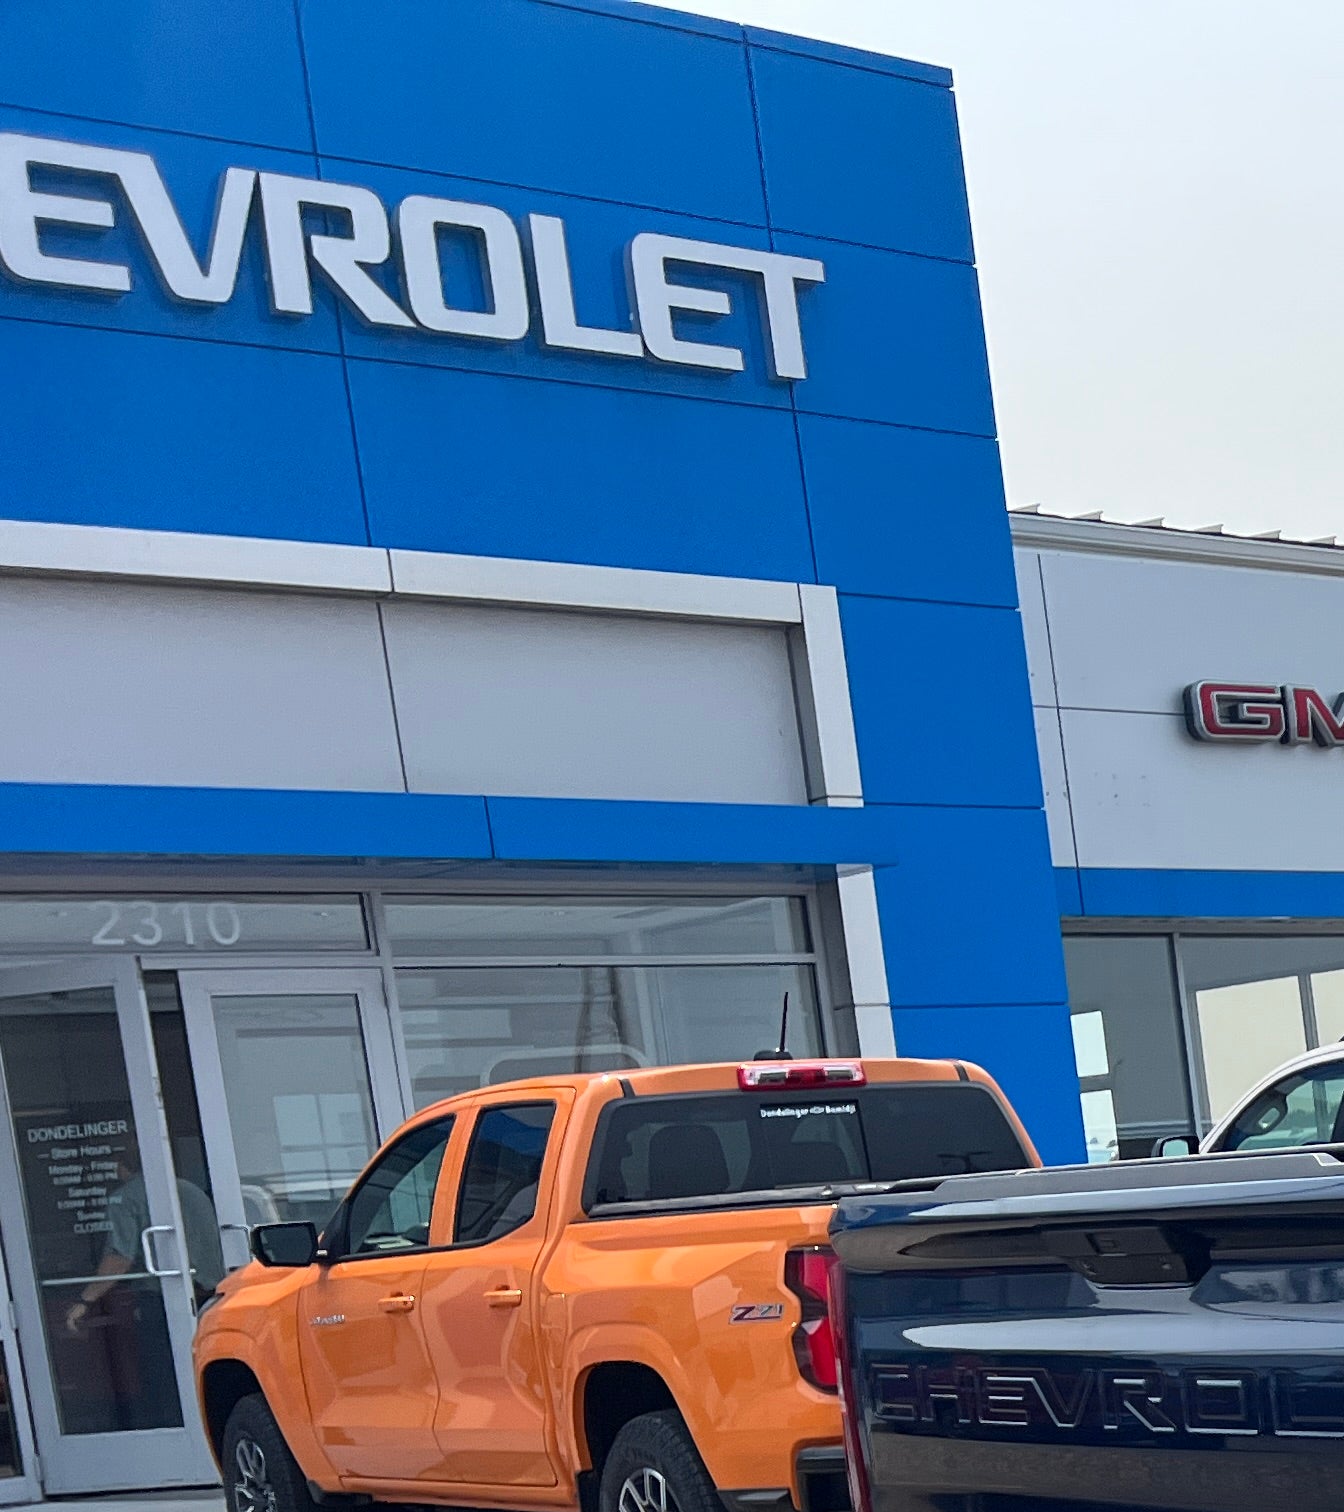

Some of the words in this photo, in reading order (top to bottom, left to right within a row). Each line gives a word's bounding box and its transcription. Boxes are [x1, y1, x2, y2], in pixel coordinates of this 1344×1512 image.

[91, 900, 241, 946] 2310
[27, 1119, 128, 1143] DONDELINGER
[730, 1304, 783, 1323] Z71
